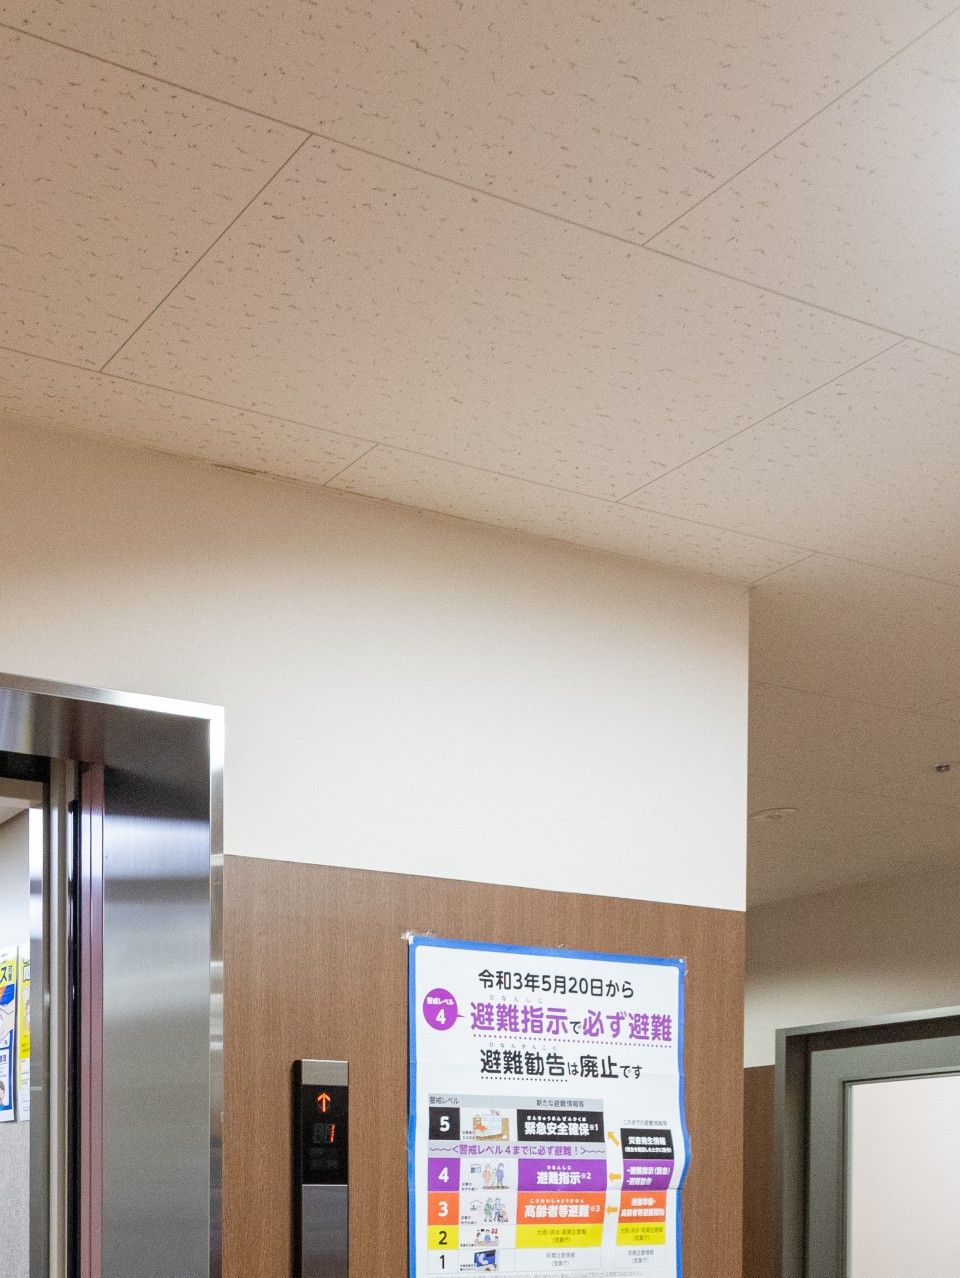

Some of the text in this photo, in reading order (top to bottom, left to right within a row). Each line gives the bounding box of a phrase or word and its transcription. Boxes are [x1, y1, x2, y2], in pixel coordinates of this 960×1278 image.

[478, 969, 634, 998] 令和3年5月20日から
[436, 1008, 446, 1025] 4
[470, 1002, 672, 1041] 避難指示で必ず避難
[480, 1049, 642, 1080] 避難勧告は廃止です
[440, 1115, 451, 1132] 5
[438, 1166, 450, 1183] 4
[437, 1200, 449, 1217] 3
[438, 1230, 448, 1246] 2
[439, 1254, 445, 1270] 1
